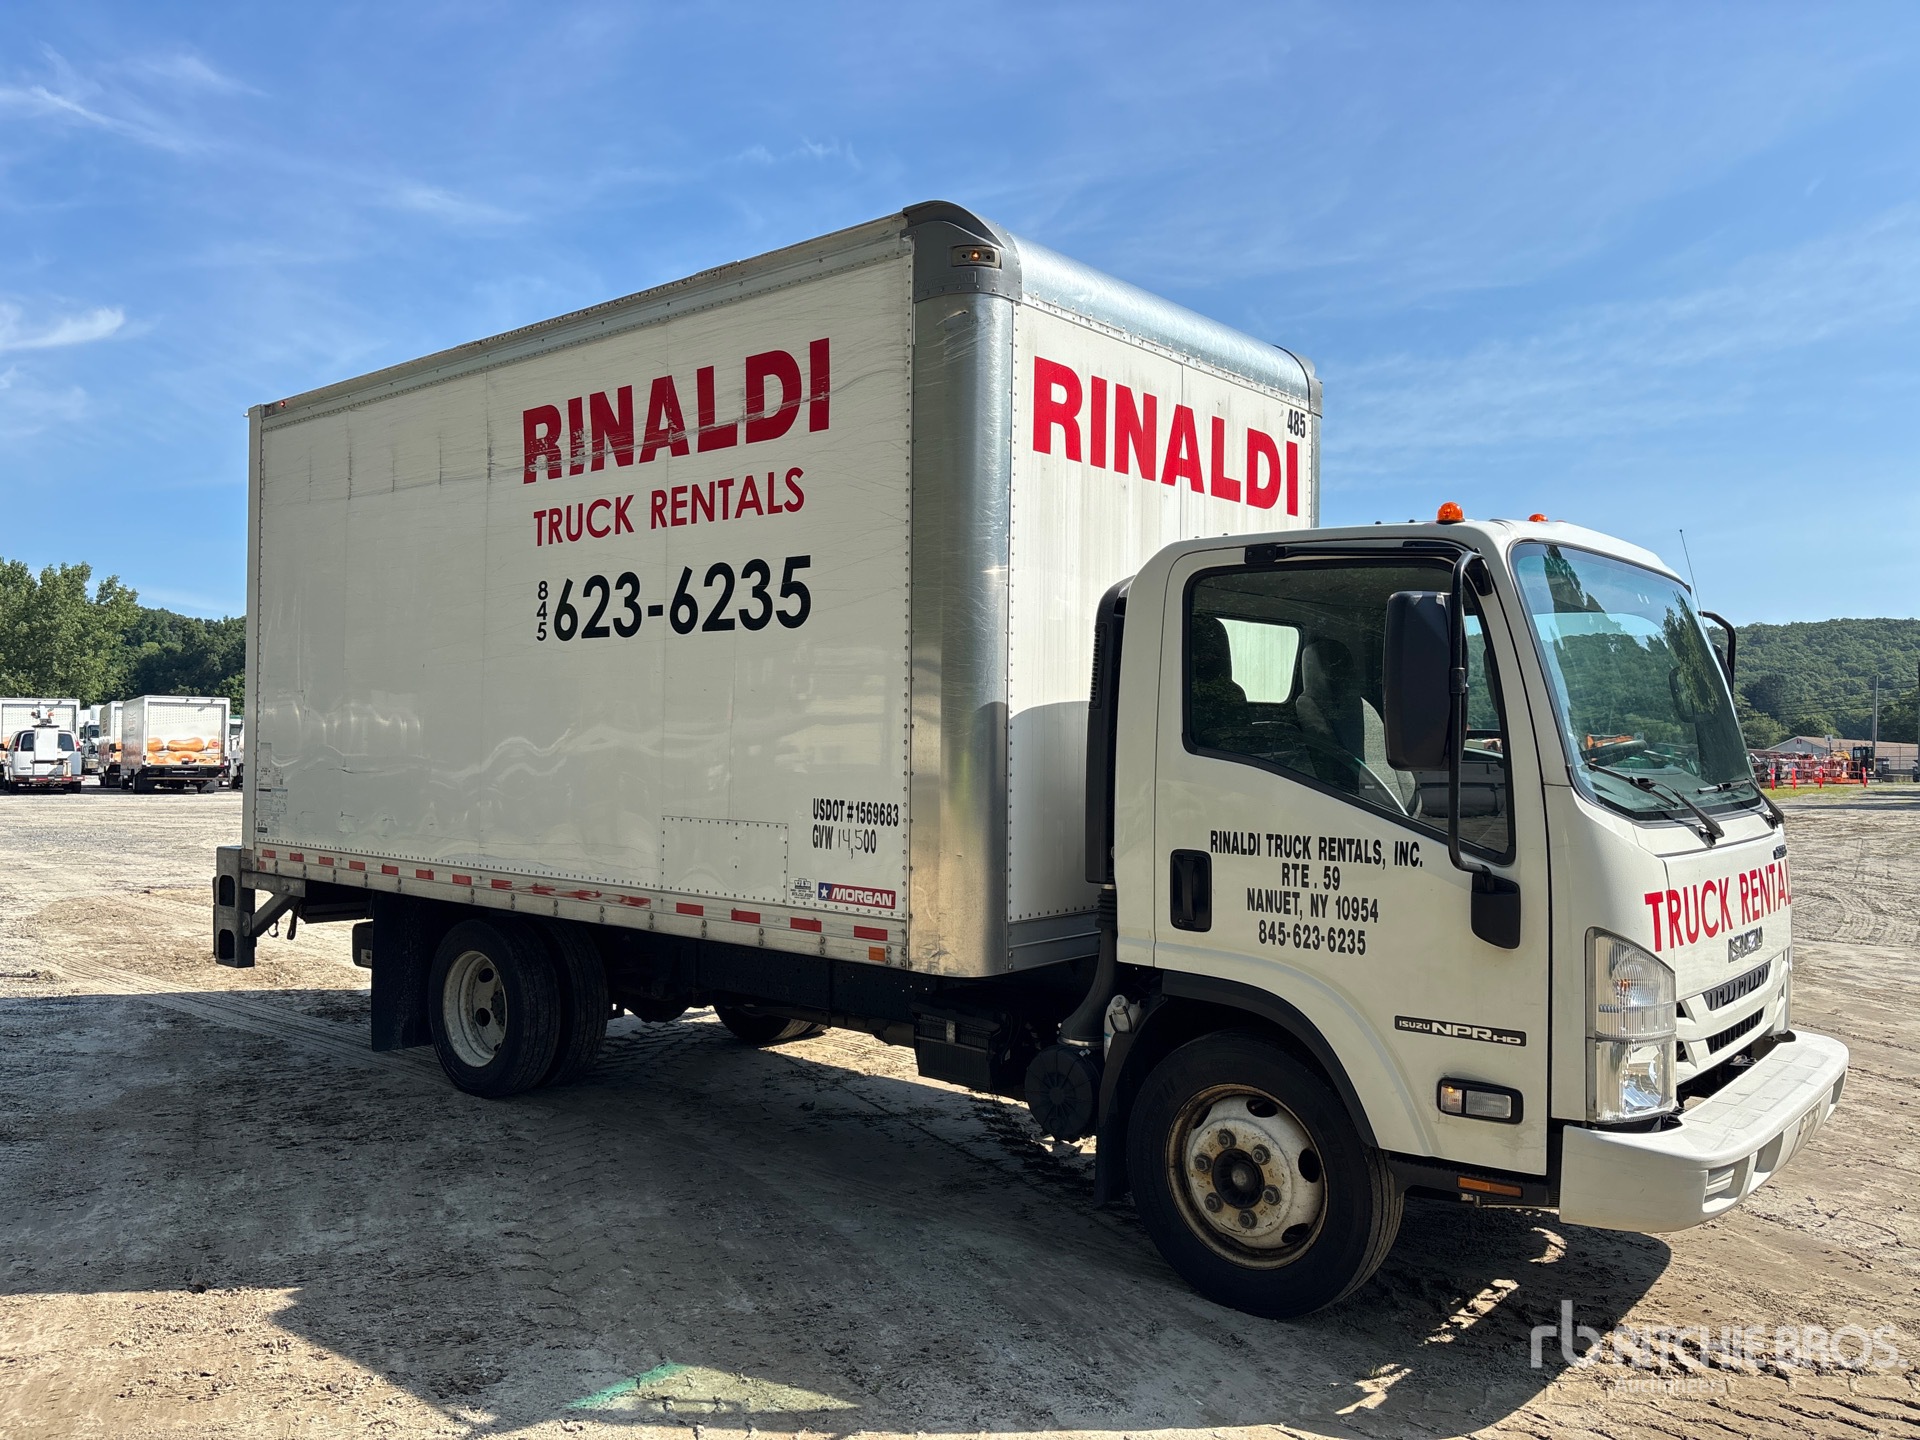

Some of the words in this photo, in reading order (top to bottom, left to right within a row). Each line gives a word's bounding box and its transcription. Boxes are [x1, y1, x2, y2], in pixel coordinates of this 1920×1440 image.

[523, 337, 830, 484] RINALDI
[1287, 408, 1307, 439] 485
[1032, 355, 1299, 517] RINALDI
[533, 494, 635, 547] TRUCK
[650, 466, 805, 530] RENTALS
[553, 554, 812, 642] 623-6235
[812, 824, 834, 850] GVW
[837, 828, 877, 860] 14,500
[1210, 830, 1261, 857] RINALDI
[1266, 833, 1312, 860] TRUCK
[1318, 836, 1386, 870] RENTALS,
[1394, 840, 1423, 868] INC.
[831, 887, 893, 907] MORGAN
[1323, 866, 1341, 891] 59
[1247, 887, 1303, 921] NANUET,
[1310, 893, 1329, 919] NY
[1335, 895, 1379, 924] 10954
[1644, 876, 1734, 953] TRUCK
[1258, 919, 1366, 956] 845-623-6235
[1399, 1019, 1430, 1031] ISUZU
